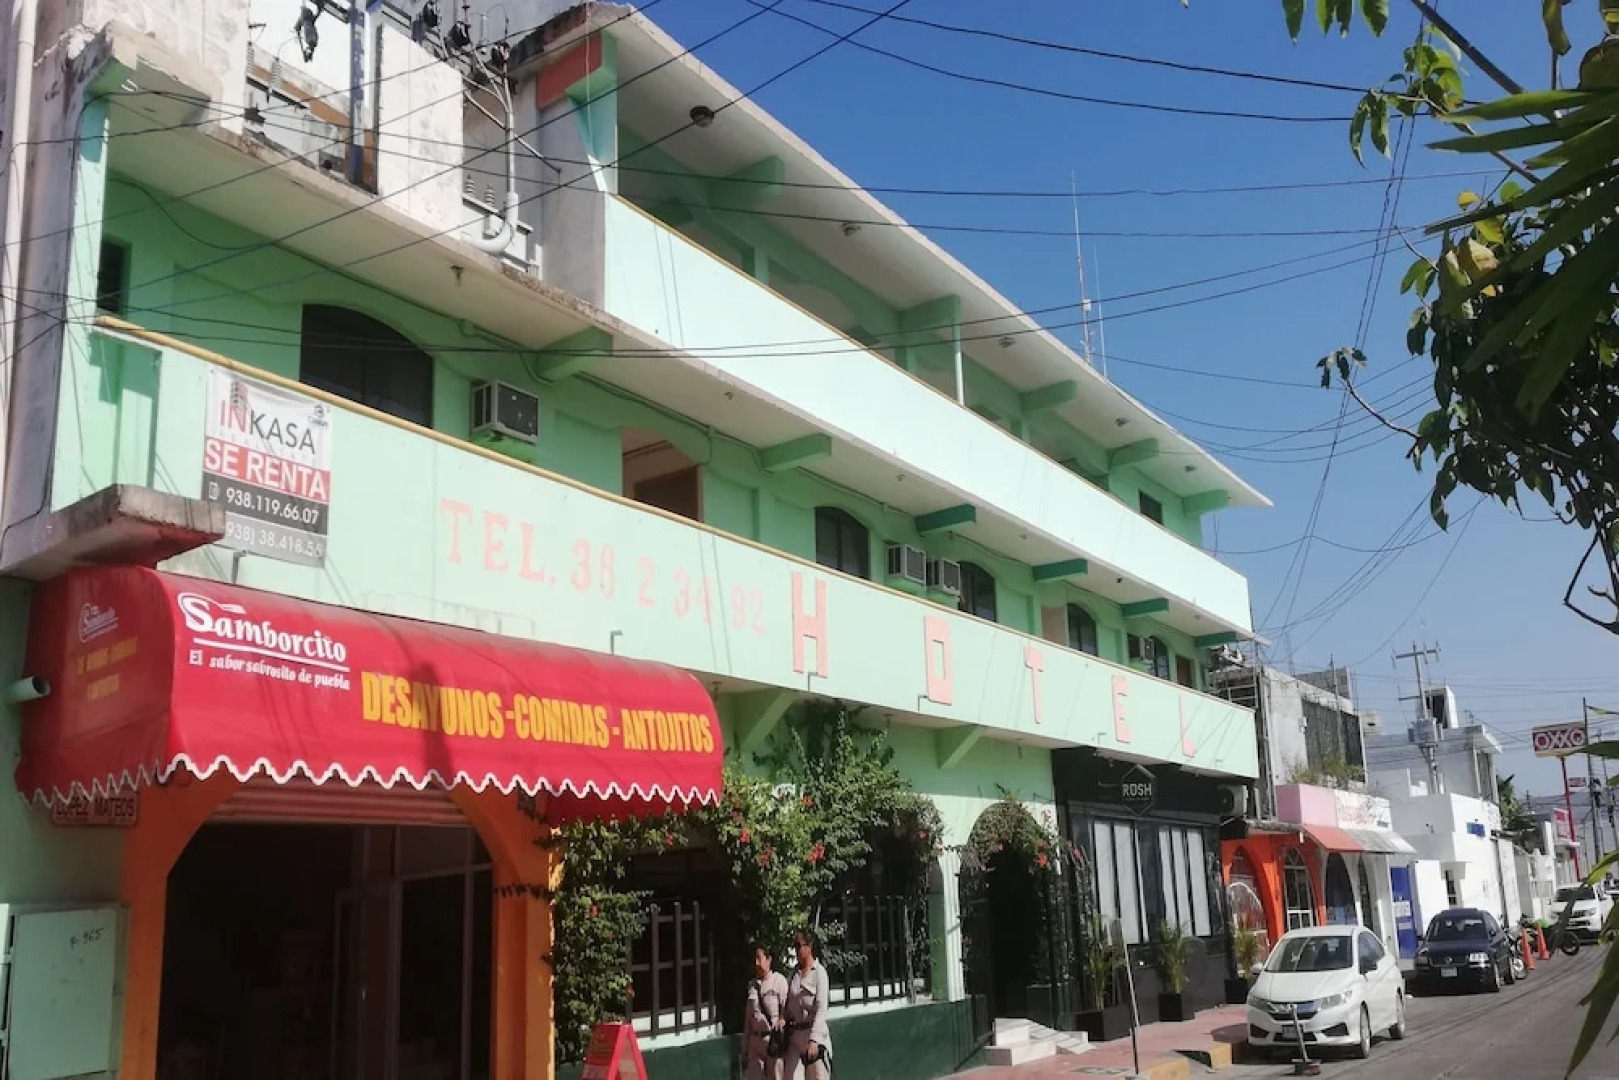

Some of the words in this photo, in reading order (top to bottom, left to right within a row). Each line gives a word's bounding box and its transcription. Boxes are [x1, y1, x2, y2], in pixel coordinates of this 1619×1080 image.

[220, 382, 316, 455] INKASA
[205, 439, 240, 477] SE
[246, 450, 326, 499] RENTA
[226, 487, 319, 524] 938.119.66.07
[441, 498, 556, 586] TEL.
[636, 555, 656, 608] 2
[178, 592, 347, 662] Samborcito
[189, 649, 203, 665] El
[209, 653, 246, 671] sabor
[246, 660, 296, 682] sabrosito
[298, 668, 312, 684] de
[1534, 728, 1586, 750] OXXO
[94, 797, 134, 817] MATEOS
[1122, 783, 1152, 797] ROSH
